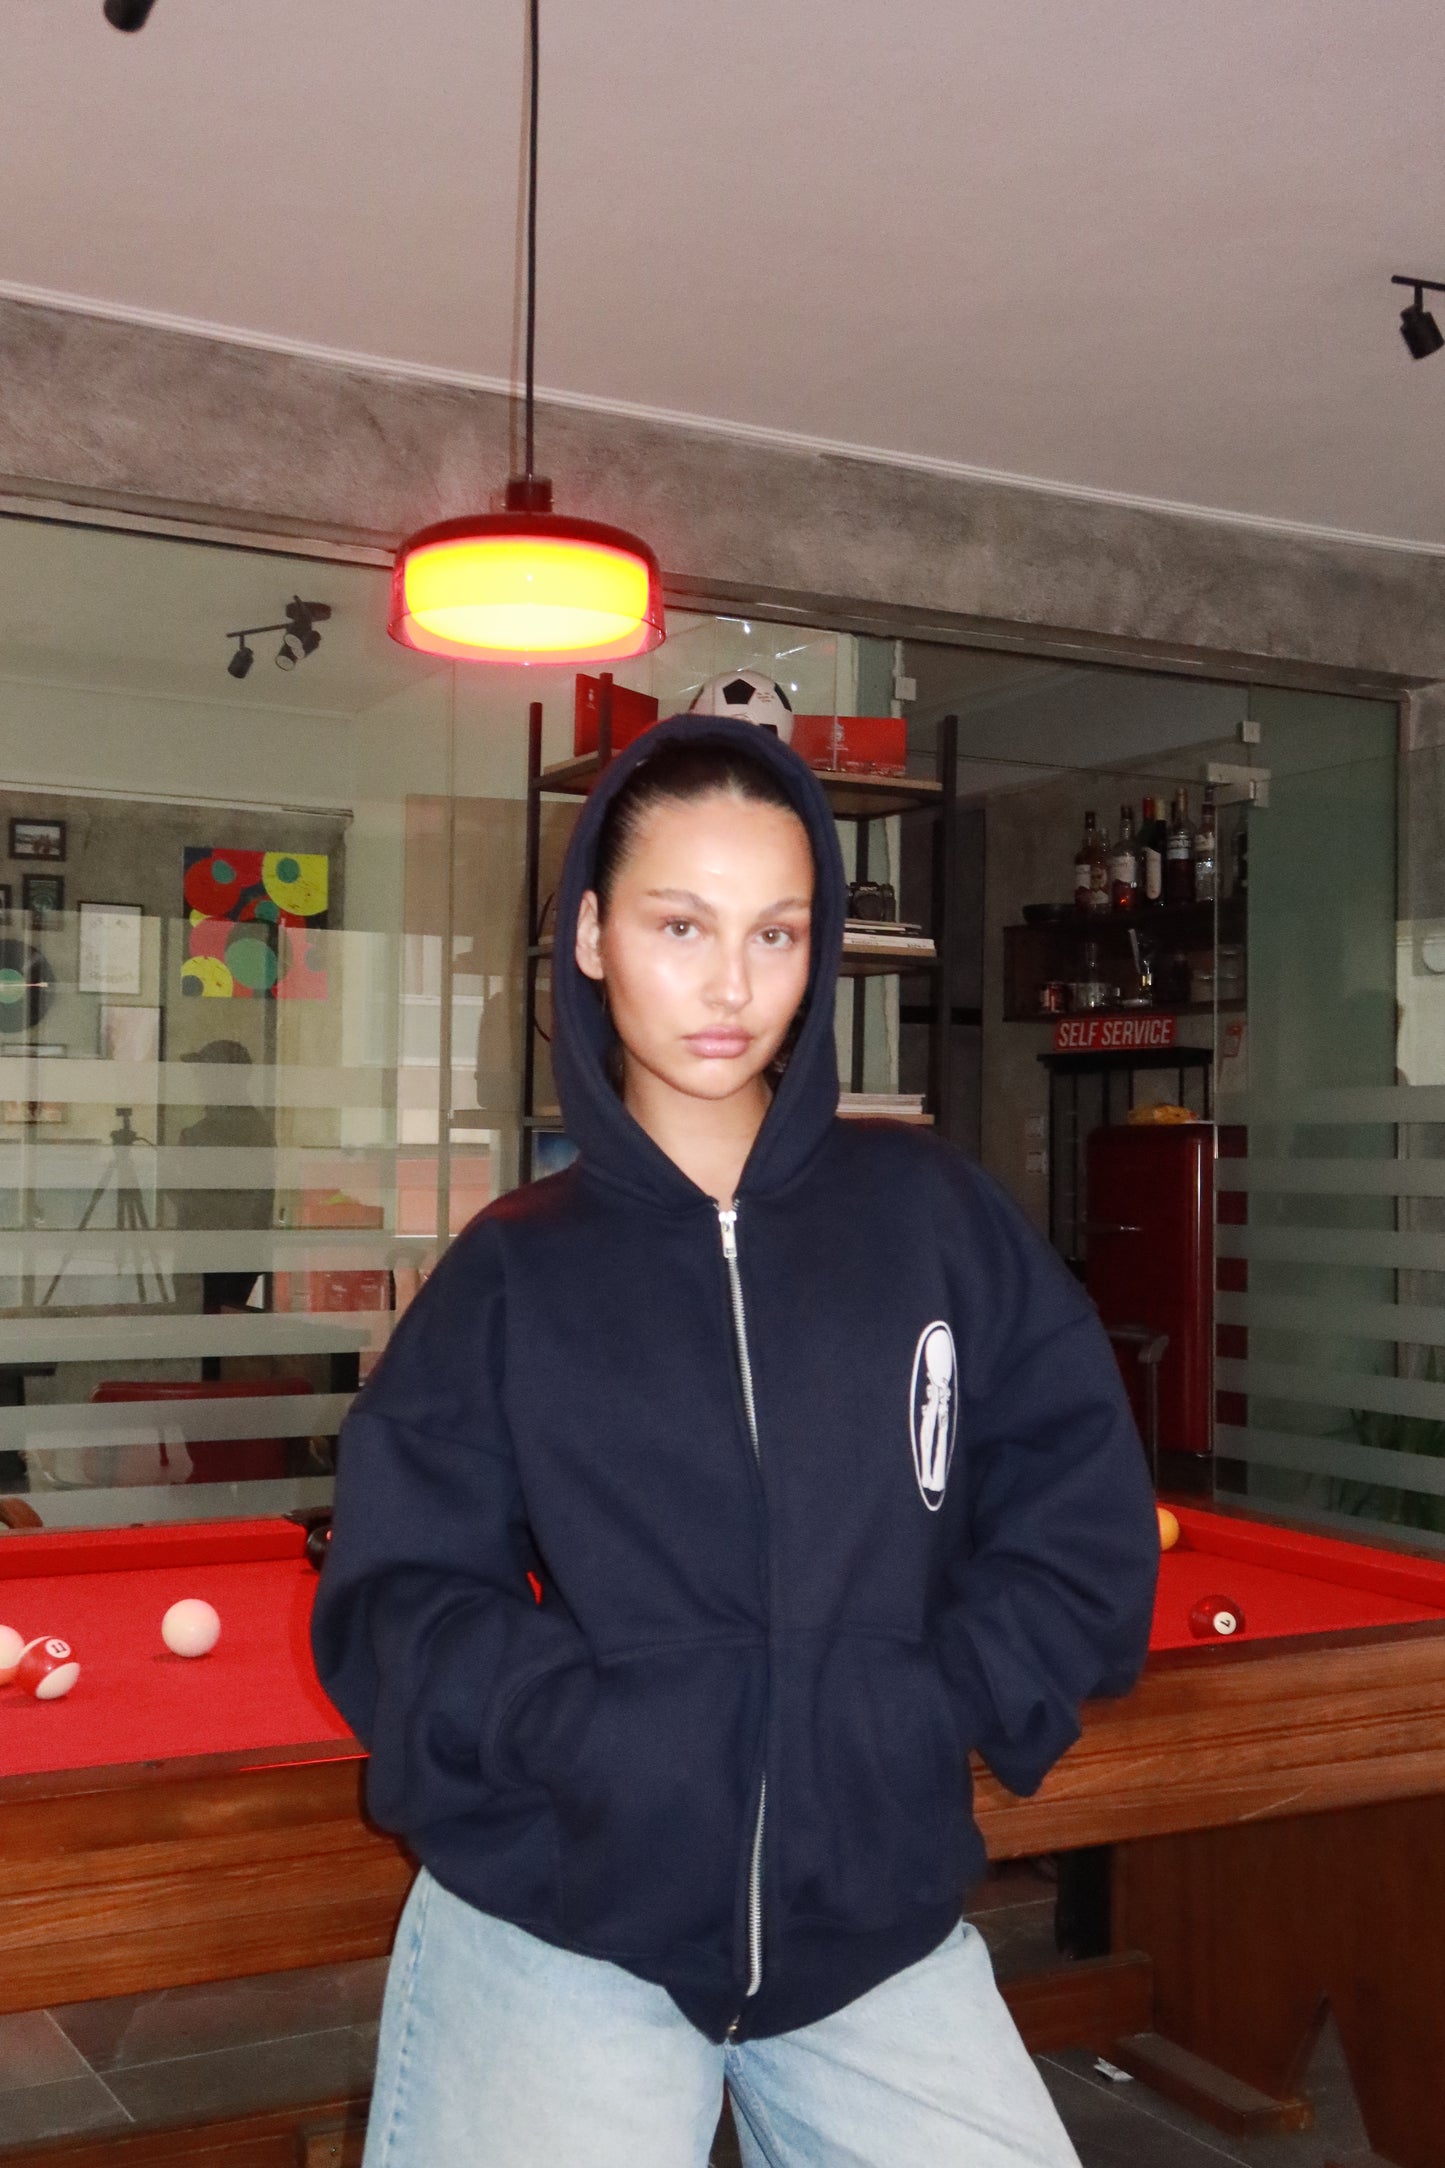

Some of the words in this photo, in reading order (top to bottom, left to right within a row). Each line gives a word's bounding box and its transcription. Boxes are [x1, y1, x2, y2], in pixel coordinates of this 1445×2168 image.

[1059, 1022, 1098, 1047] SELF
[1101, 1019, 1172, 1046] SERVICE
[51, 1642, 67, 1653] 11
